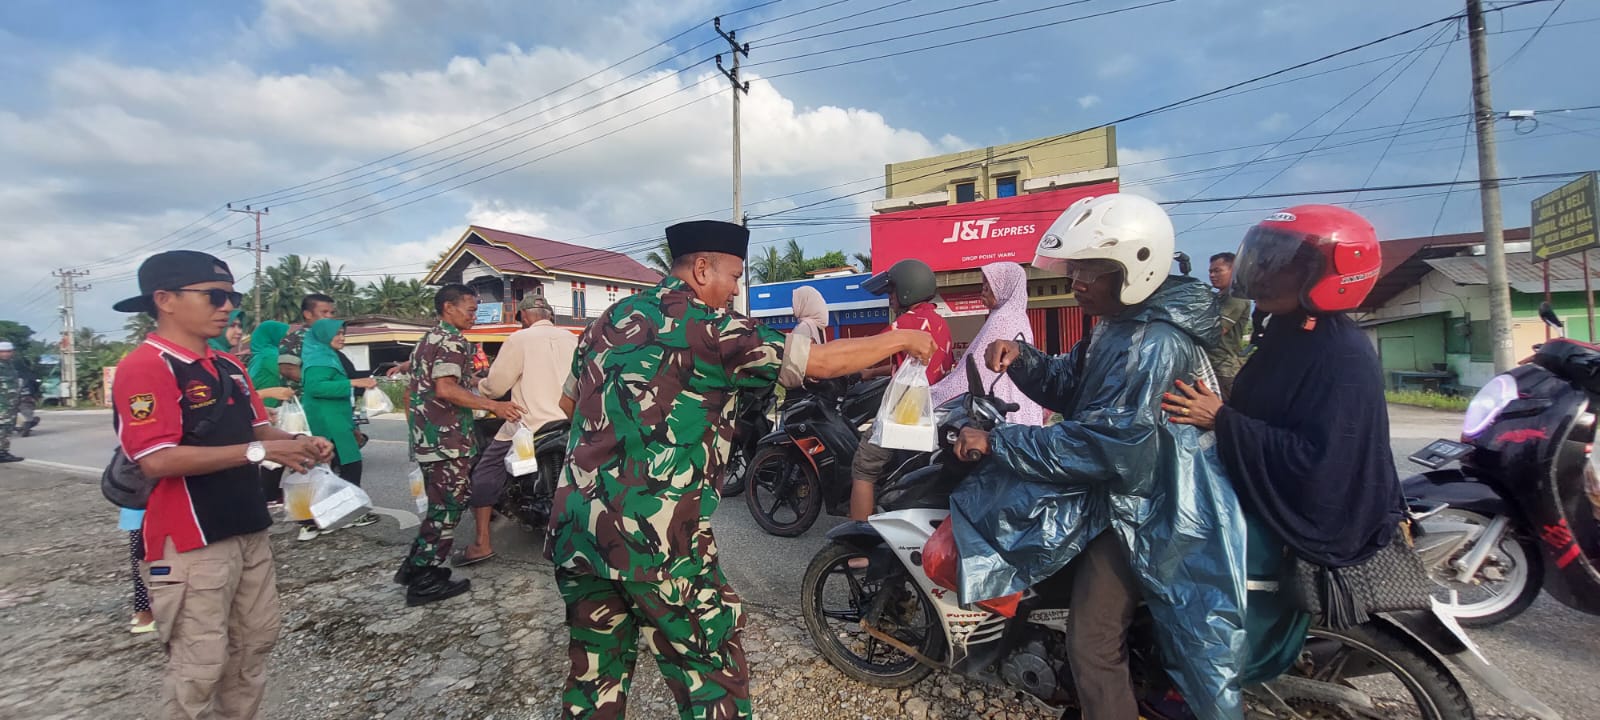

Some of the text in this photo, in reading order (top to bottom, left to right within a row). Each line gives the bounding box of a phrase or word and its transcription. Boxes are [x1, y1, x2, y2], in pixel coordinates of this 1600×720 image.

[1558, 200, 1565, 213] &
[1566, 191, 1585, 209] BELI
[1576, 205, 1593, 221] DLL
[942, 217, 1035, 243] J&T EXPRESS
[979, 253, 996, 261] POINT
